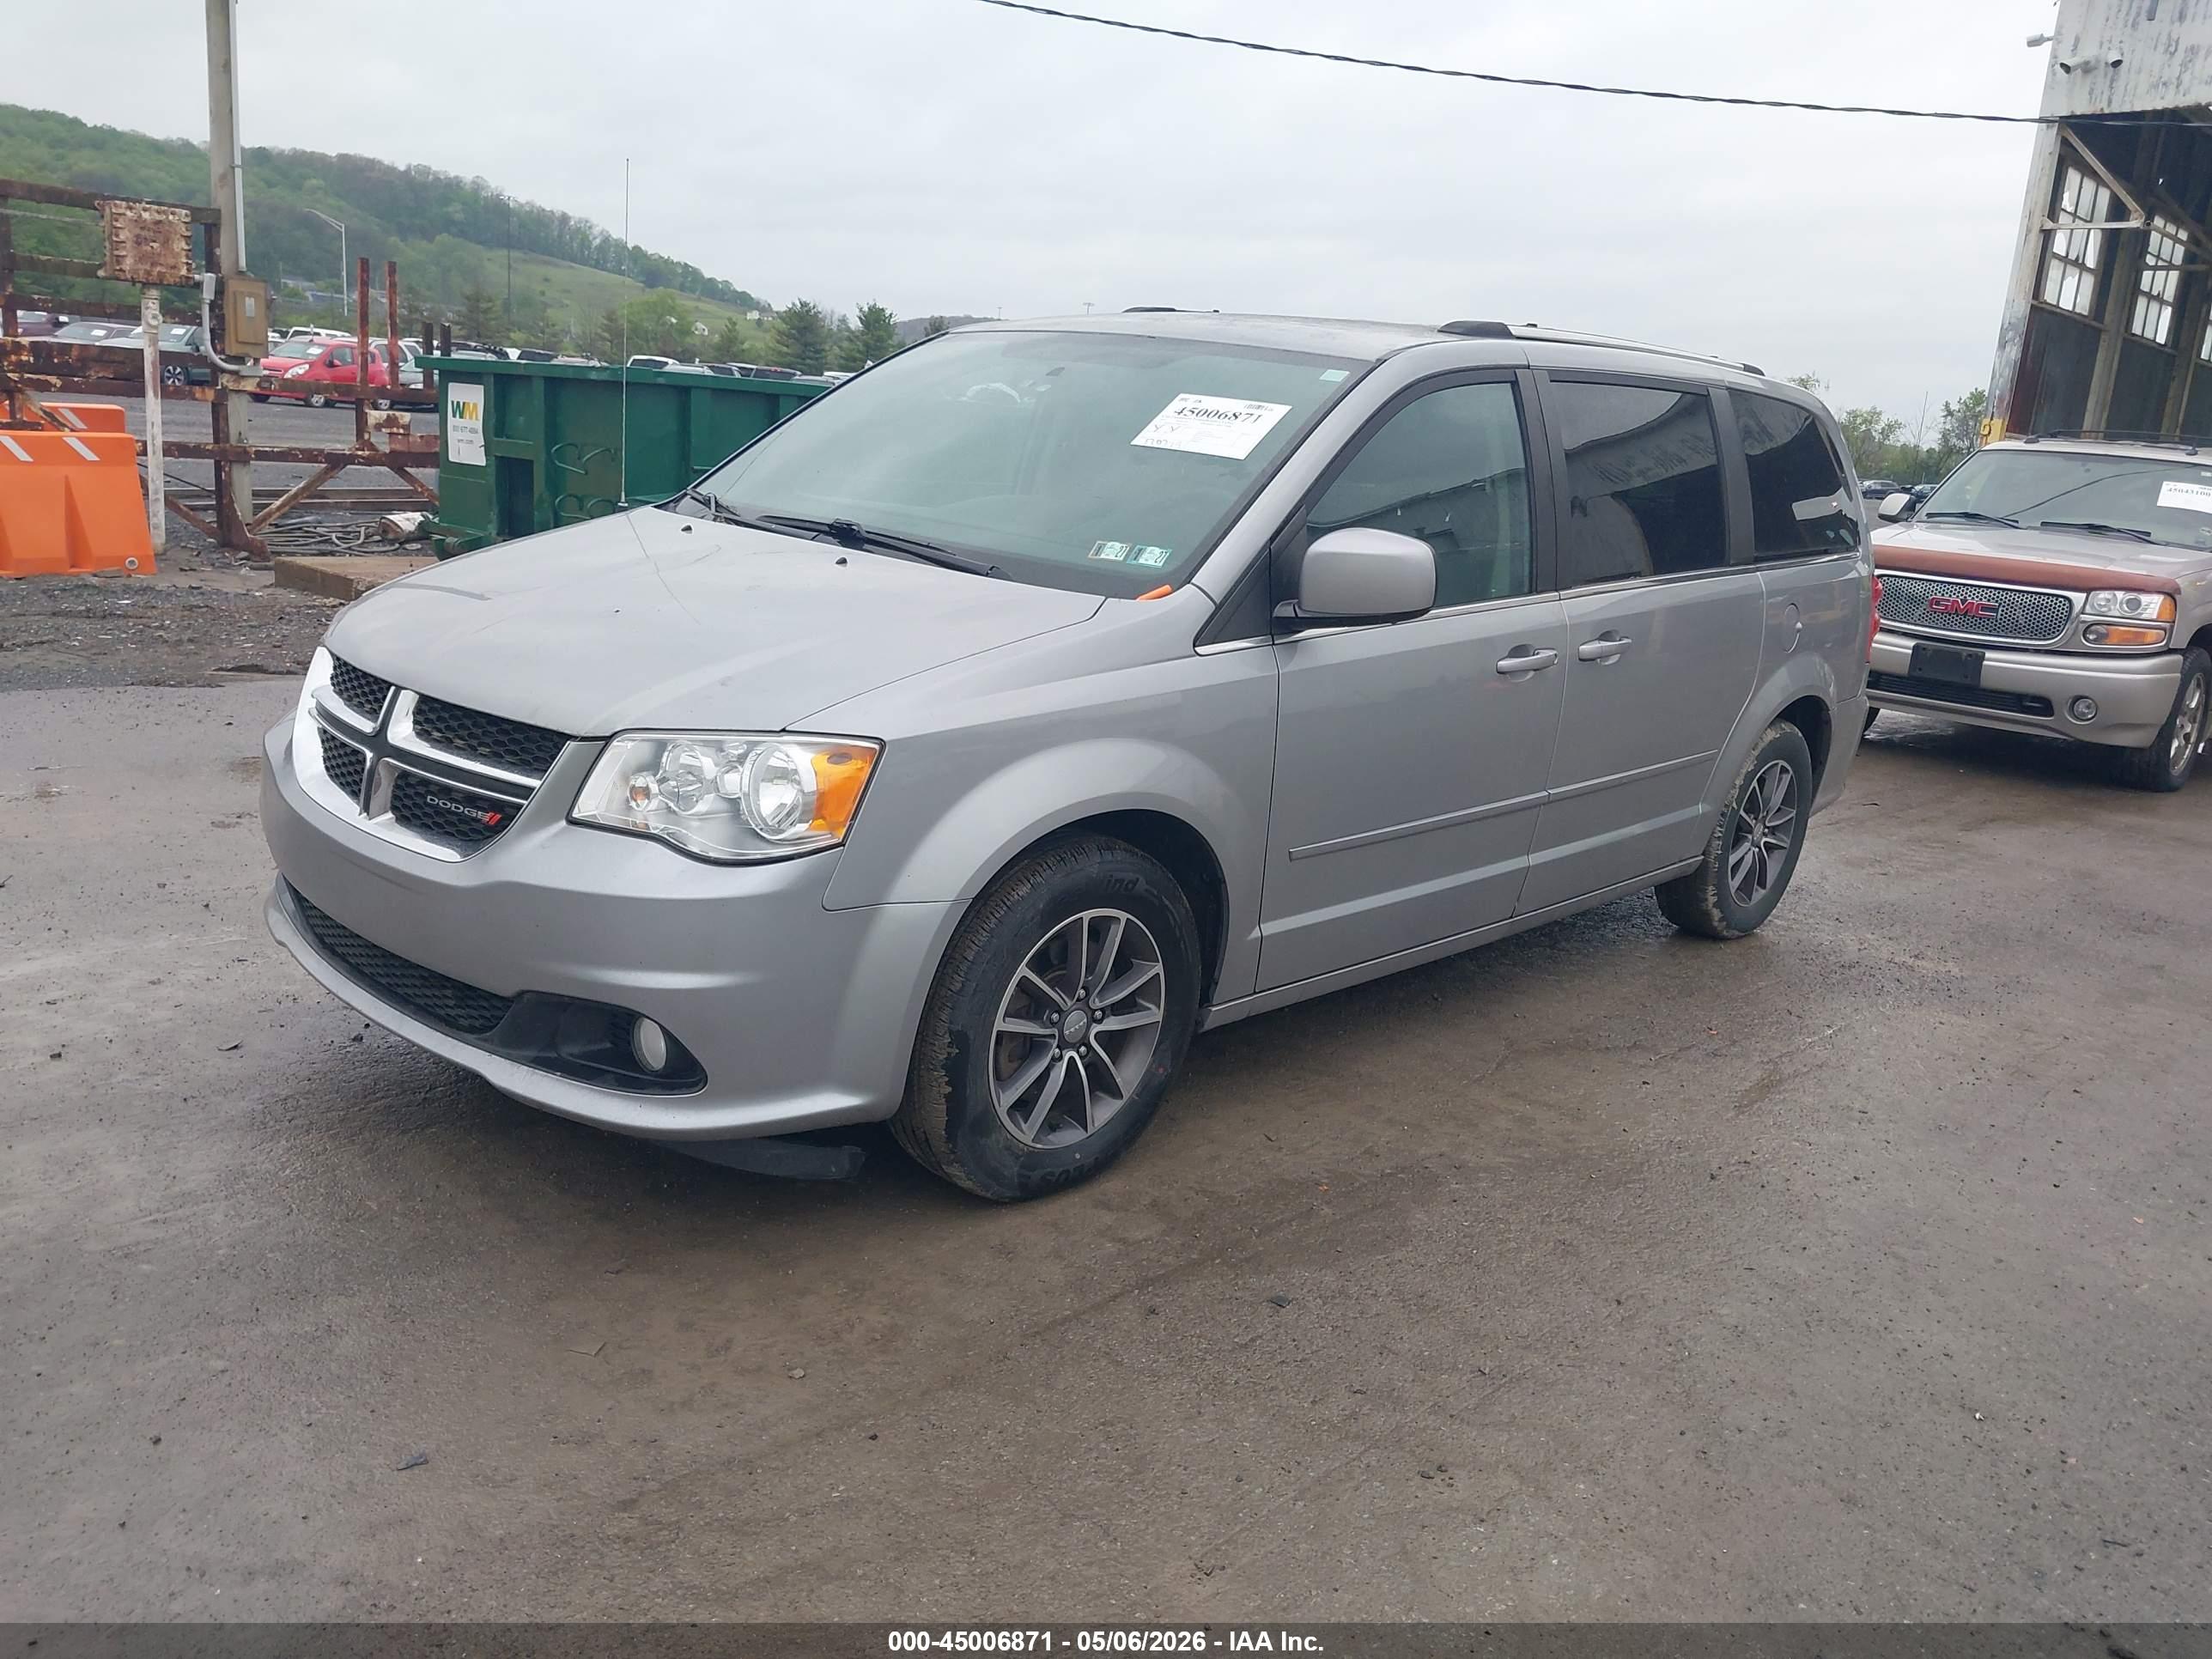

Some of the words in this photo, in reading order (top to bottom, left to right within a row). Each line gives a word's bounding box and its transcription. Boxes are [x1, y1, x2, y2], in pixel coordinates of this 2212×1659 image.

[451, 400, 479, 421] WM
[1174, 406, 1263, 424] 45006871
[1929, 596, 1999, 618] GMC
[427, 795, 490, 822] DODGE
